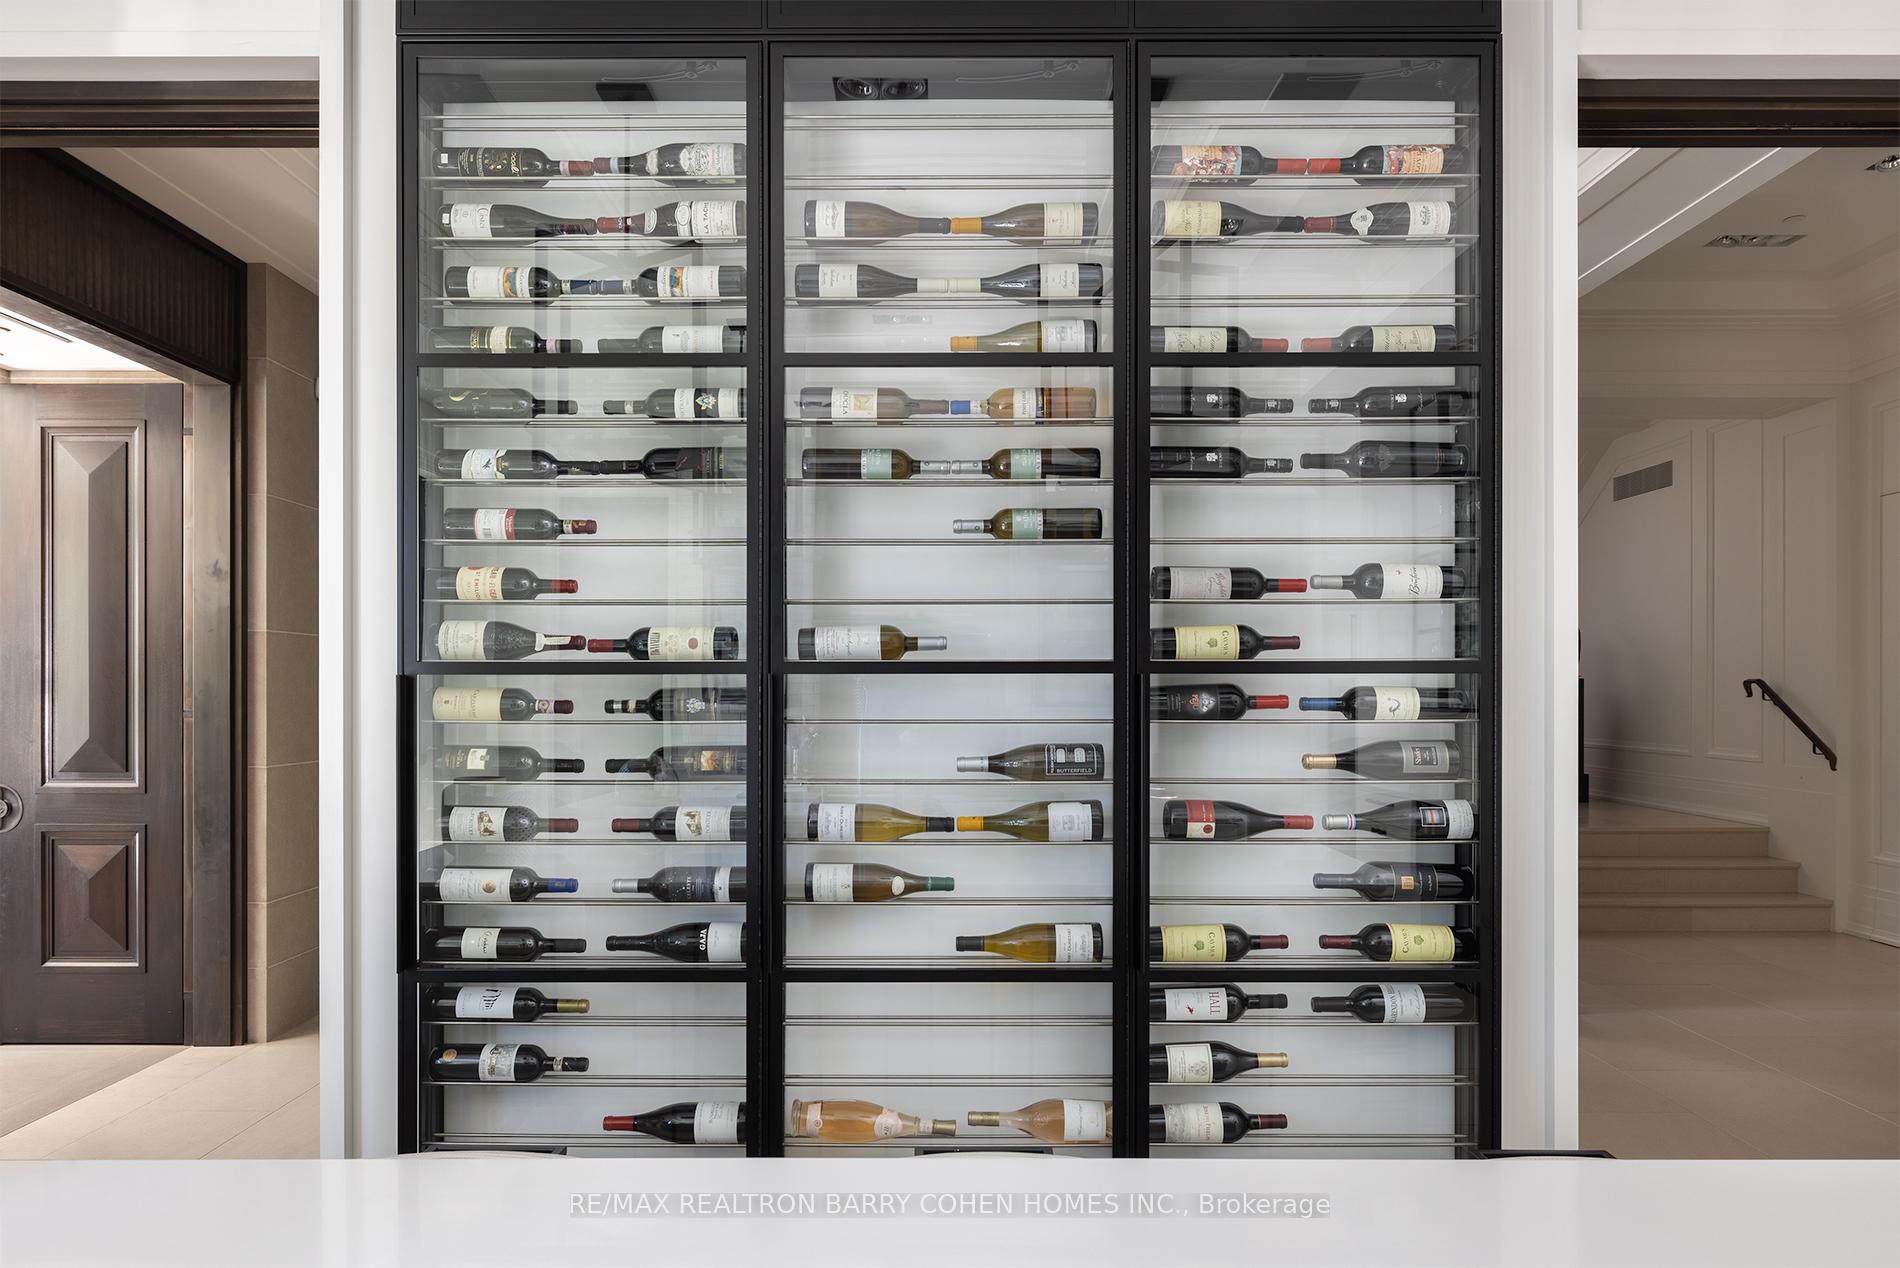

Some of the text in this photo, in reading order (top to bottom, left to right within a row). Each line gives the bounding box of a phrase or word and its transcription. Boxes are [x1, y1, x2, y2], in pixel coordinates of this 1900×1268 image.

[699, 929, 707, 950] GAJA
[1208, 932, 1216, 958] CAYMUS
[1208, 992, 1221, 1015] HALL
